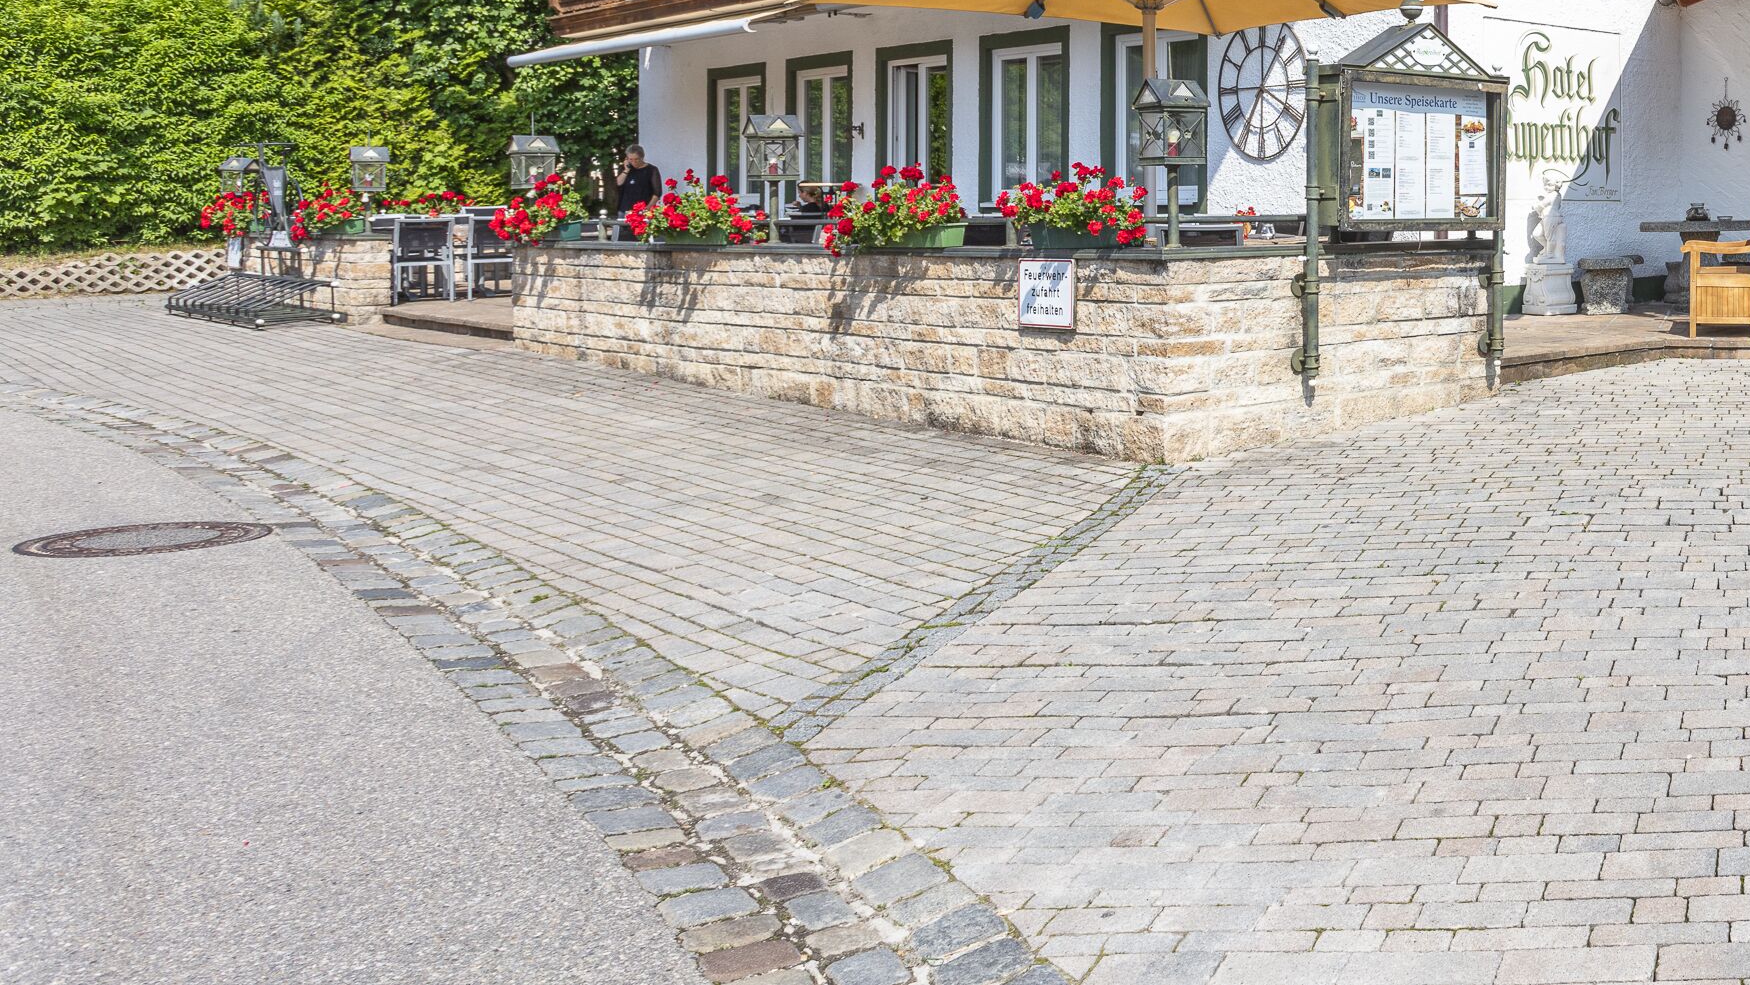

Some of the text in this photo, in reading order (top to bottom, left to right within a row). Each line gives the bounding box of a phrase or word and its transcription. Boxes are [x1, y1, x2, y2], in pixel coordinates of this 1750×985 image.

[1509, 29, 1600, 110] Hotel
[1370, 92, 1403, 106] Unsere
[1405, 94, 1458, 109] Speisekarte
[1024, 268, 1068, 281] Feuerwehr-
[1031, 286, 1060, 298] zufahrt
[1026, 303, 1064, 316] freihalten
